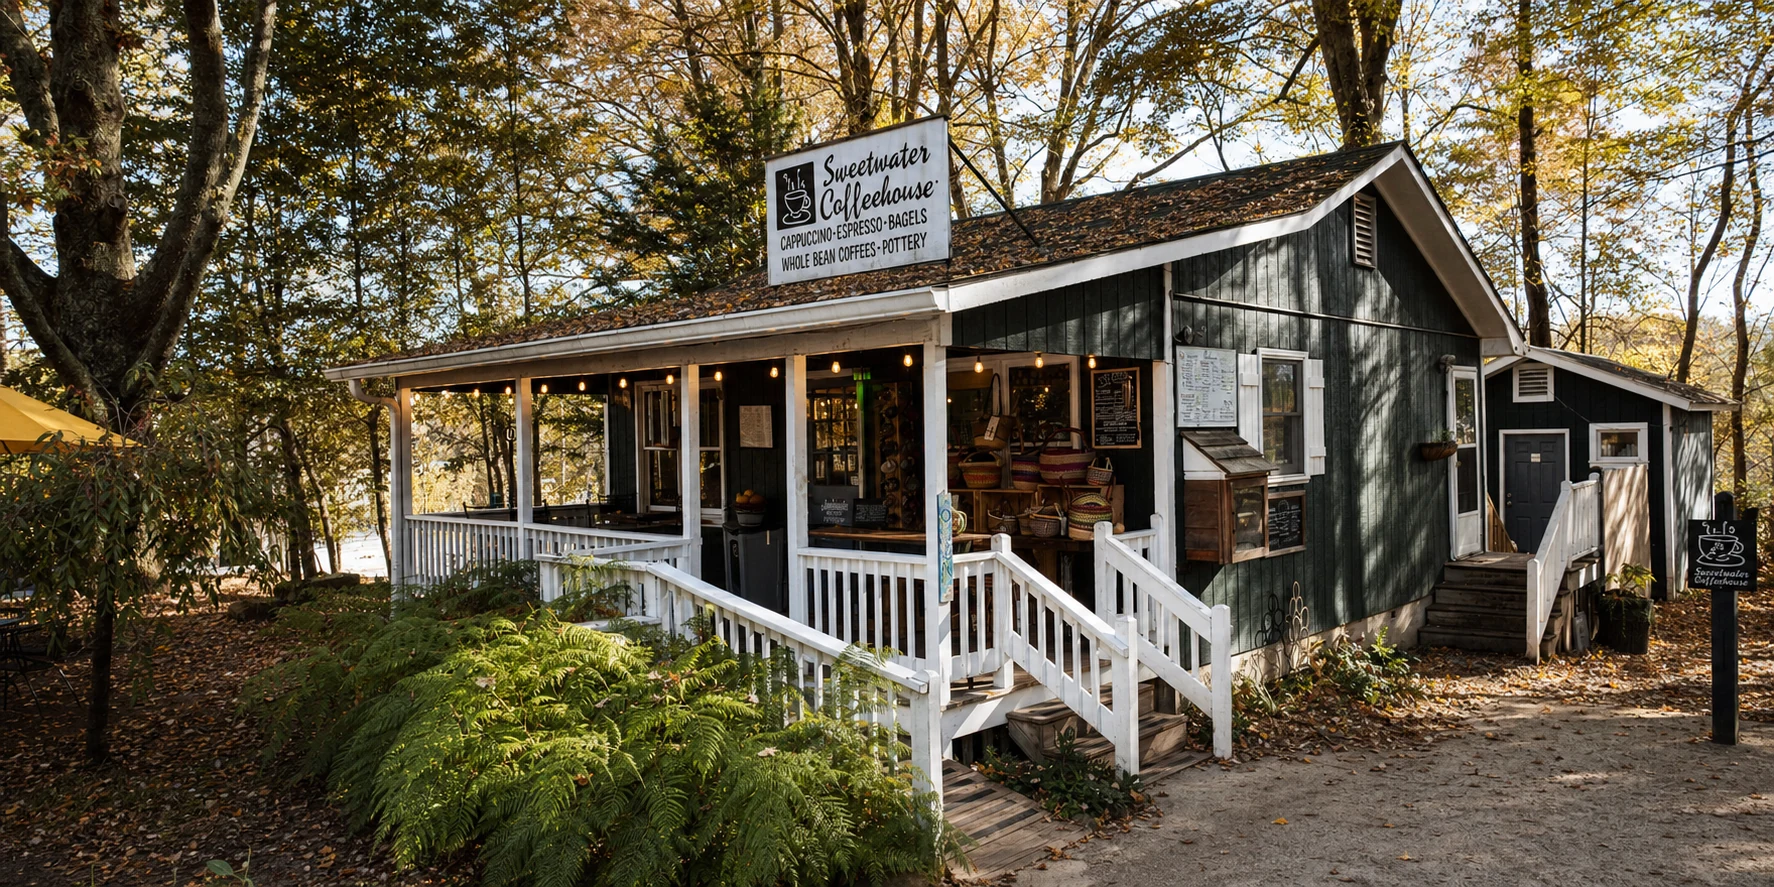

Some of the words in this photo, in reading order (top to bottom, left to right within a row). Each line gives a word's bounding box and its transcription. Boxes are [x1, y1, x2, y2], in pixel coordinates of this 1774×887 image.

[823, 142, 931, 187] Sweetwater
[820, 175, 935, 222] Coffeehouse
[780, 231, 832, 251] CAPPUCCINO
[837, 219, 883, 240] ESPRESSO
[888, 208, 927, 231] BAGELS
[781, 253, 810, 272] WHOLE
[813, 250, 836, 266] BEAN
[838, 242, 877, 263] COFFEES
[882, 232, 927, 256] POTTERY
